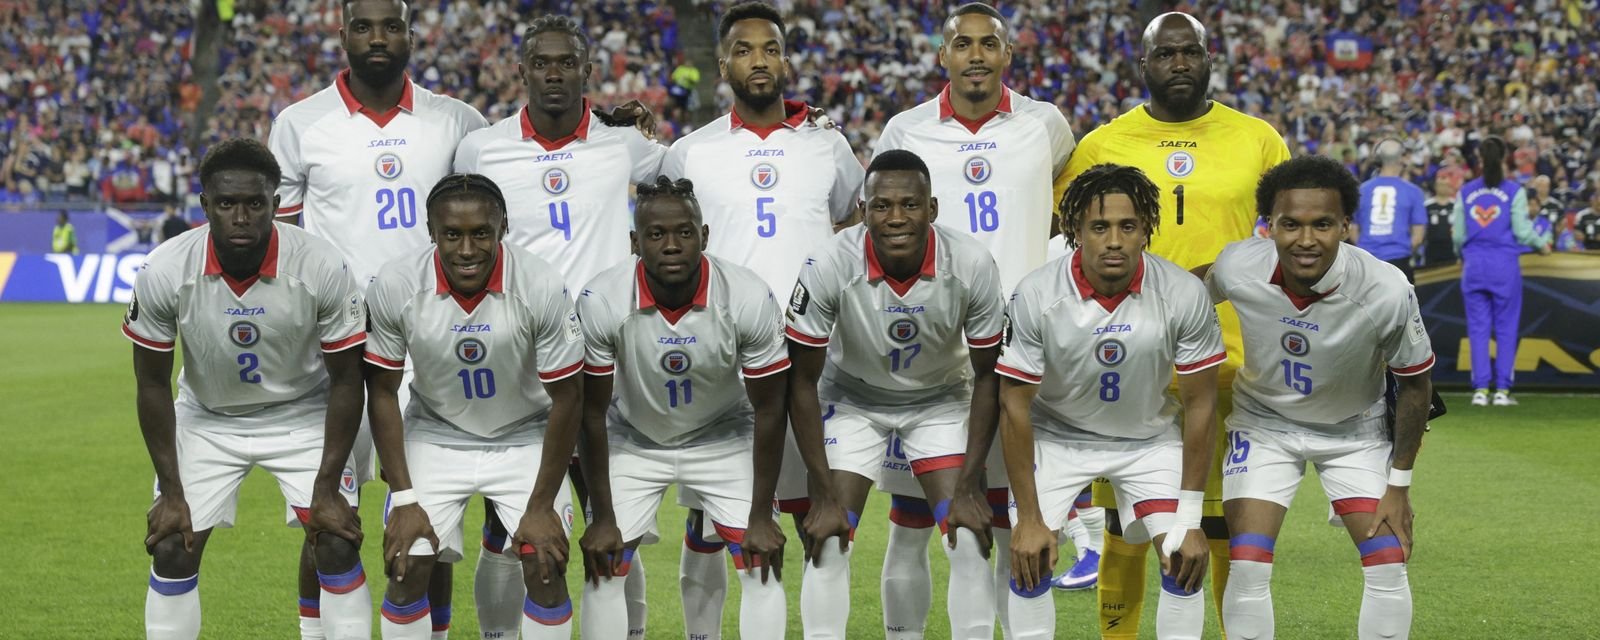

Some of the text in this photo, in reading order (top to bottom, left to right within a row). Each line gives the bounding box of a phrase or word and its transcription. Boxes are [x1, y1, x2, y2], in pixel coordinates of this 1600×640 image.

[368, 138, 407, 148] SAETA
[958, 141, 998, 153] SAETA
[1157, 140, 1197, 148] SAETA
[536, 151, 573, 162] SAETA
[746, 148, 785, 158] SAETA
[375, 186, 417, 231] 20
[964, 190, 1000, 233] 18
[1172, 184, 1185, 226] 1
[548, 201, 572, 241] 4
[756, 197, 777, 239] 5
[44, 253, 146, 303] VIS
[224, 307, 266, 317] SAETA
[885, 305, 925, 314] SAETA
[451, 323, 493, 334] SAETA
[1093, 323, 1133, 336] SAETA
[1279, 316, 1320, 333] SAETA
[658, 335, 697, 346] SAETA
[889, 343, 921, 369] 17
[237, 351, 262, 383] 2
[458, 367, 496, 400] 10
[1282, 359, 1313, 395] 15
[666, 379, 692, 407] 11
[1100, 371, 1121, 402] 8
[1224, 465, 1249, 477] AETA
[1102, 602, 1125, 611] FHF
[484, 631, 505, 639] FHF
